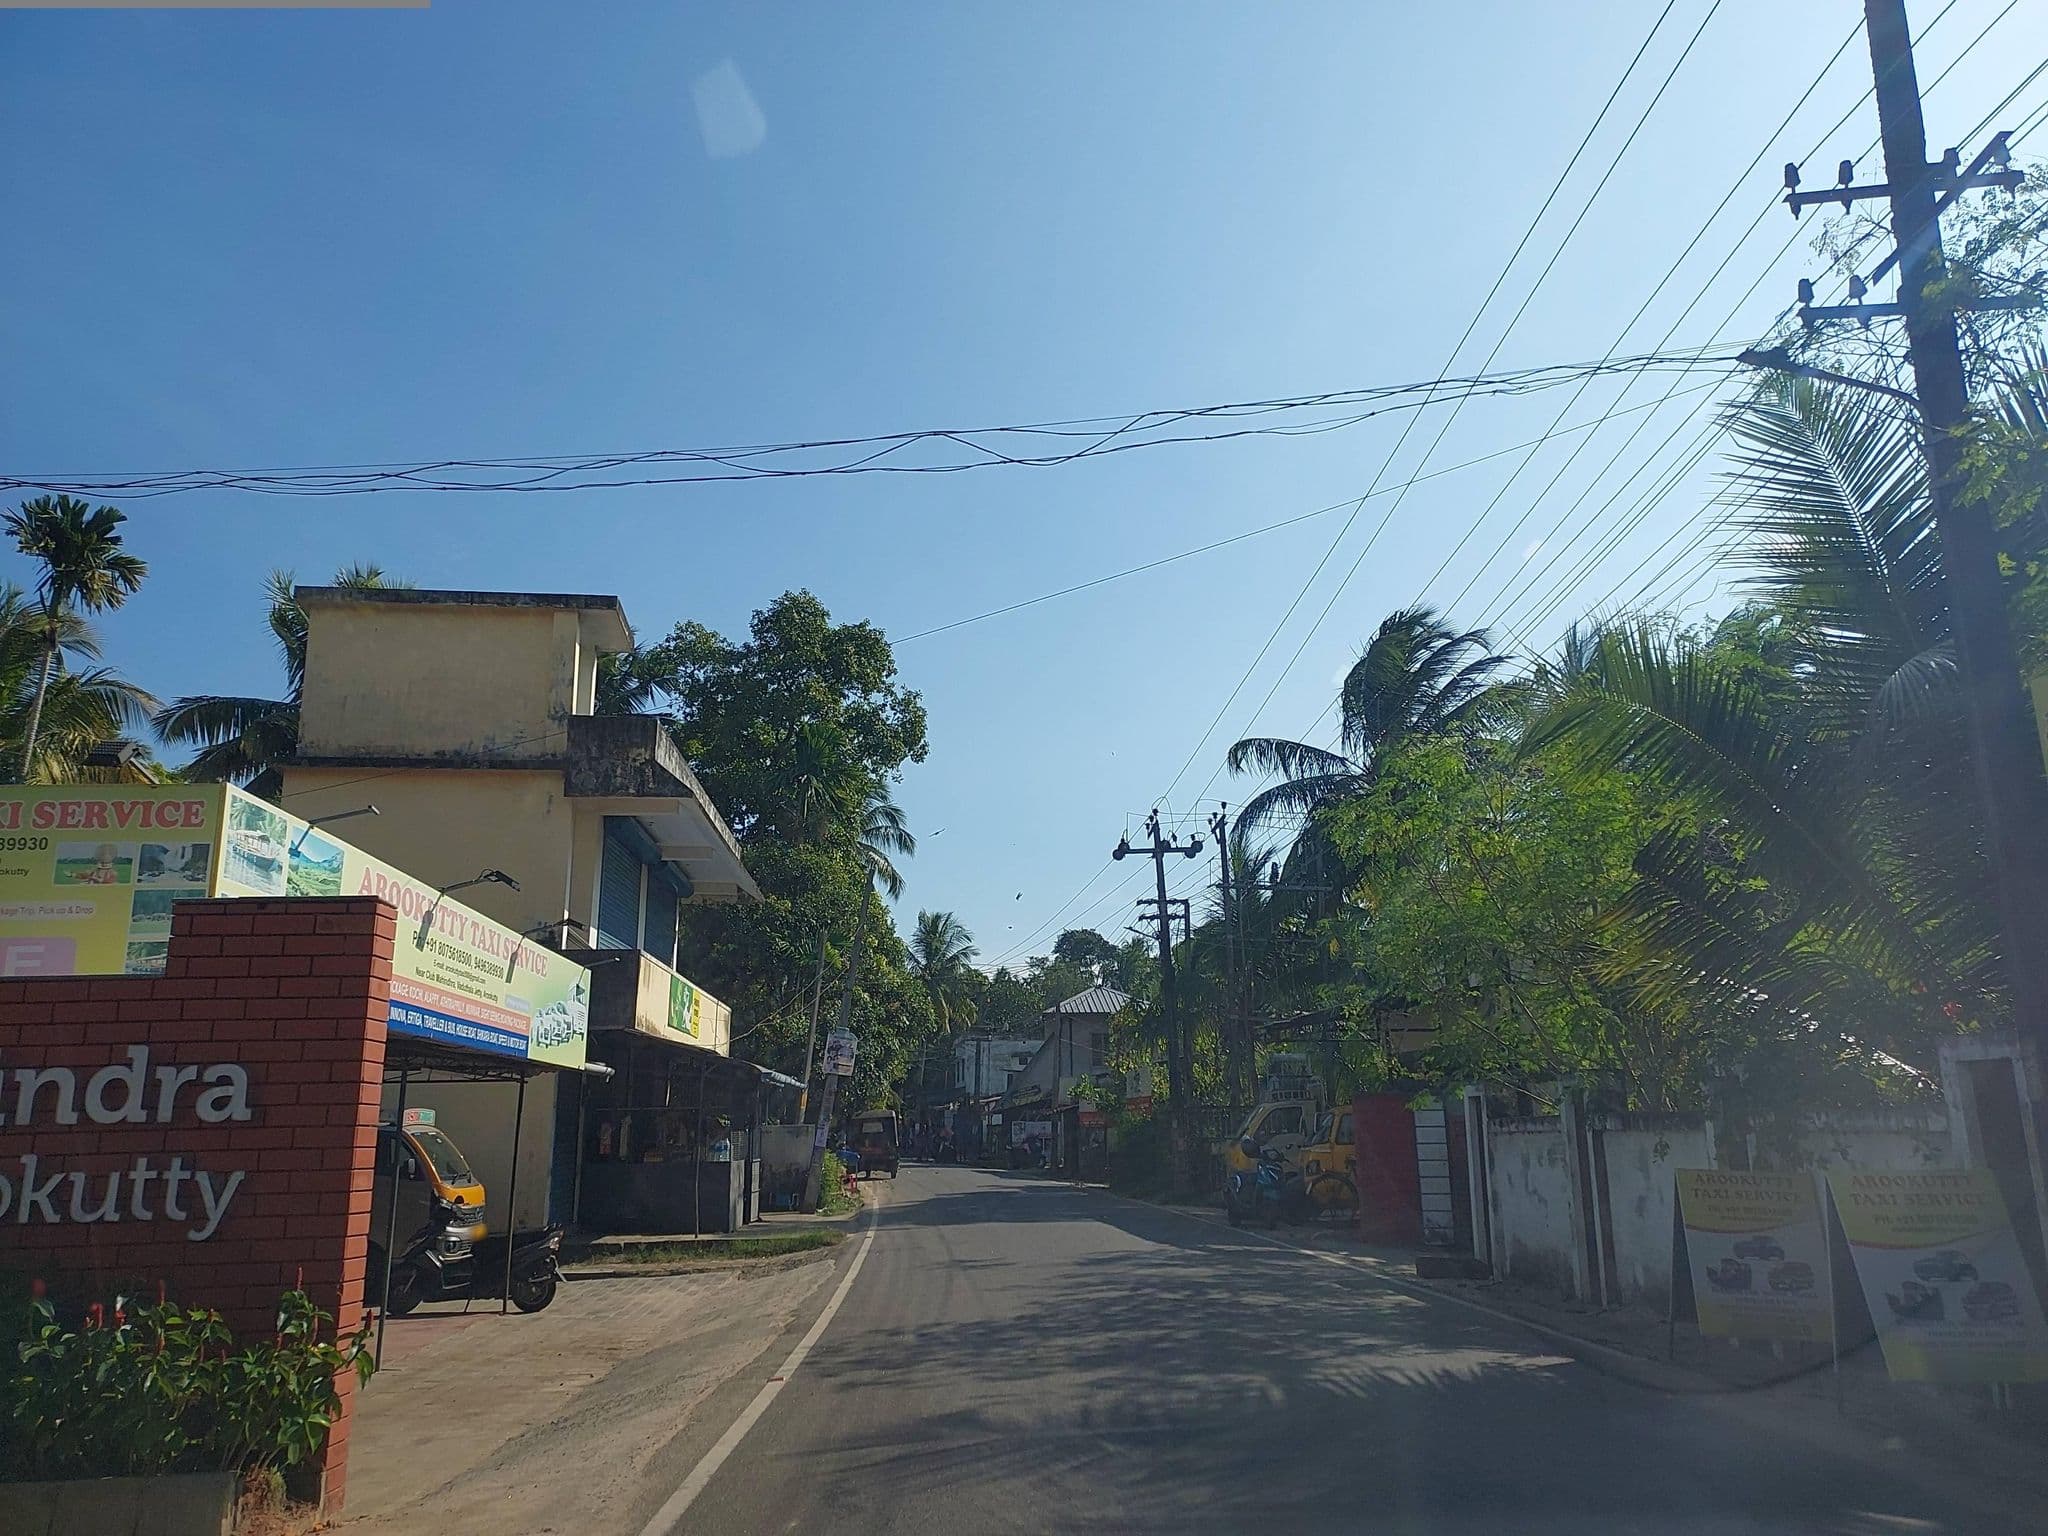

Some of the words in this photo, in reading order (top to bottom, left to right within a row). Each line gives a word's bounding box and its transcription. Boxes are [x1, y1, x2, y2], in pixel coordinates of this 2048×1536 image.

[32, 800, 206, 830] SERVICE
[75, 905, 94, 915] Drop
[470, 920, 501, 957] TAXI
[1690, 1187, 1729, 1200] TAXI
[1850, 1192, 1897, 1206] TAXI
